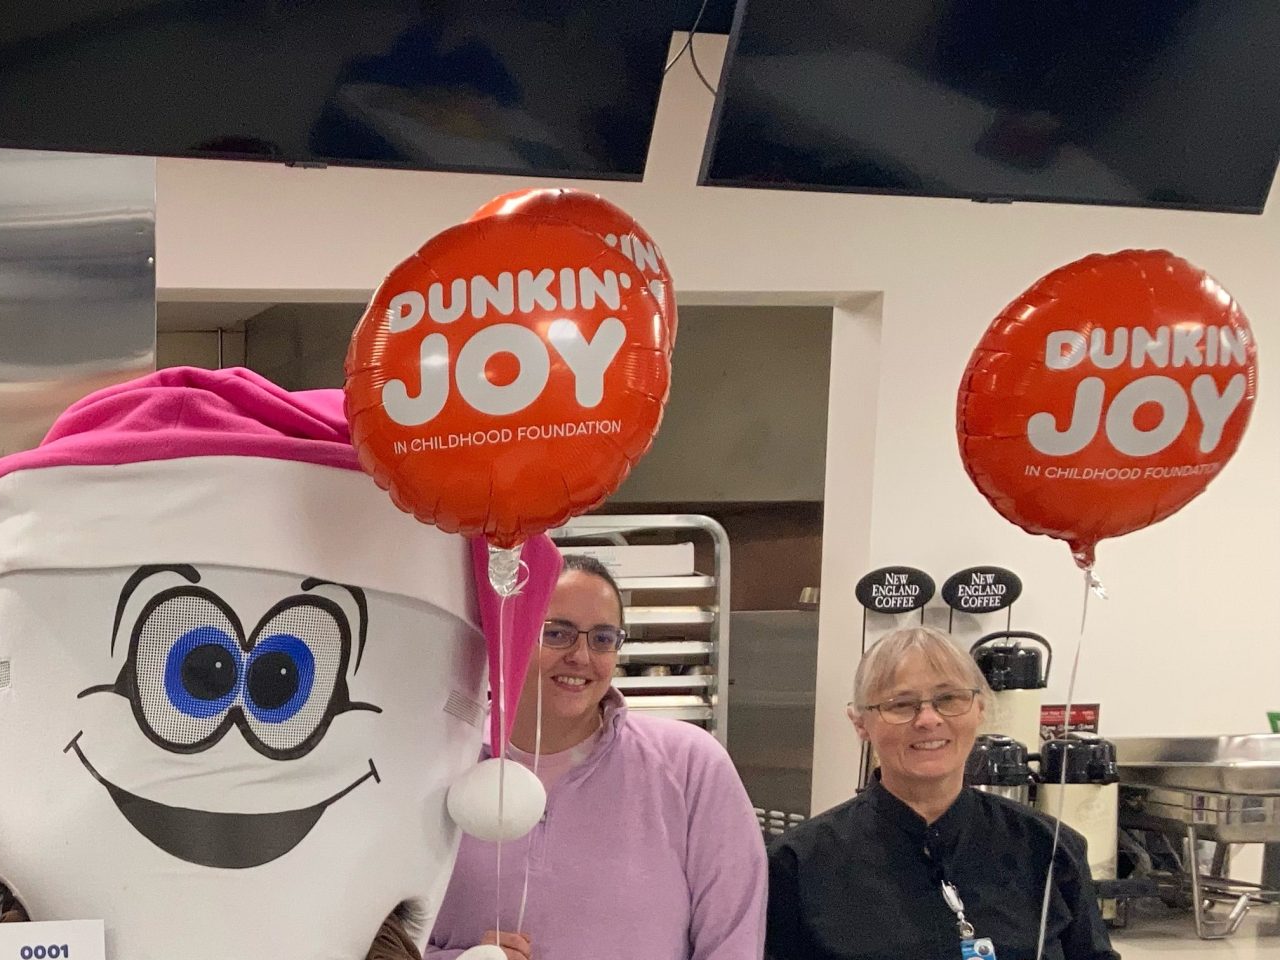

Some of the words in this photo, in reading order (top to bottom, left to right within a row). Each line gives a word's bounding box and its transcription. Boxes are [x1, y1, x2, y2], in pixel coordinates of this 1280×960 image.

[388, 266, 631, 335] DUNKIN'
[381, 316, 626, 427] JOY
[1026, 373, 1247, 457] JOY
[393, 440, 408, 455] IN
[410, 428, 512, 452] CHILDHOOD
[516, 419, 622, 441] FOUNDATION
[1024, 465, 1040, 477] IN
[1044, 466, 1141, 481] CHILDHOOD
[885, 573, 908, 585] NEW
[971, 573, 995, 585] NEW
[872, 585, 920, 596] ENGLAND
[958, 585, 1006, 596] ENGLAND
[875, 596, 915, 608] COFFEE
[961, 596, 1001, 608] COFFEE
[20, 944, 69, 960] 0001
